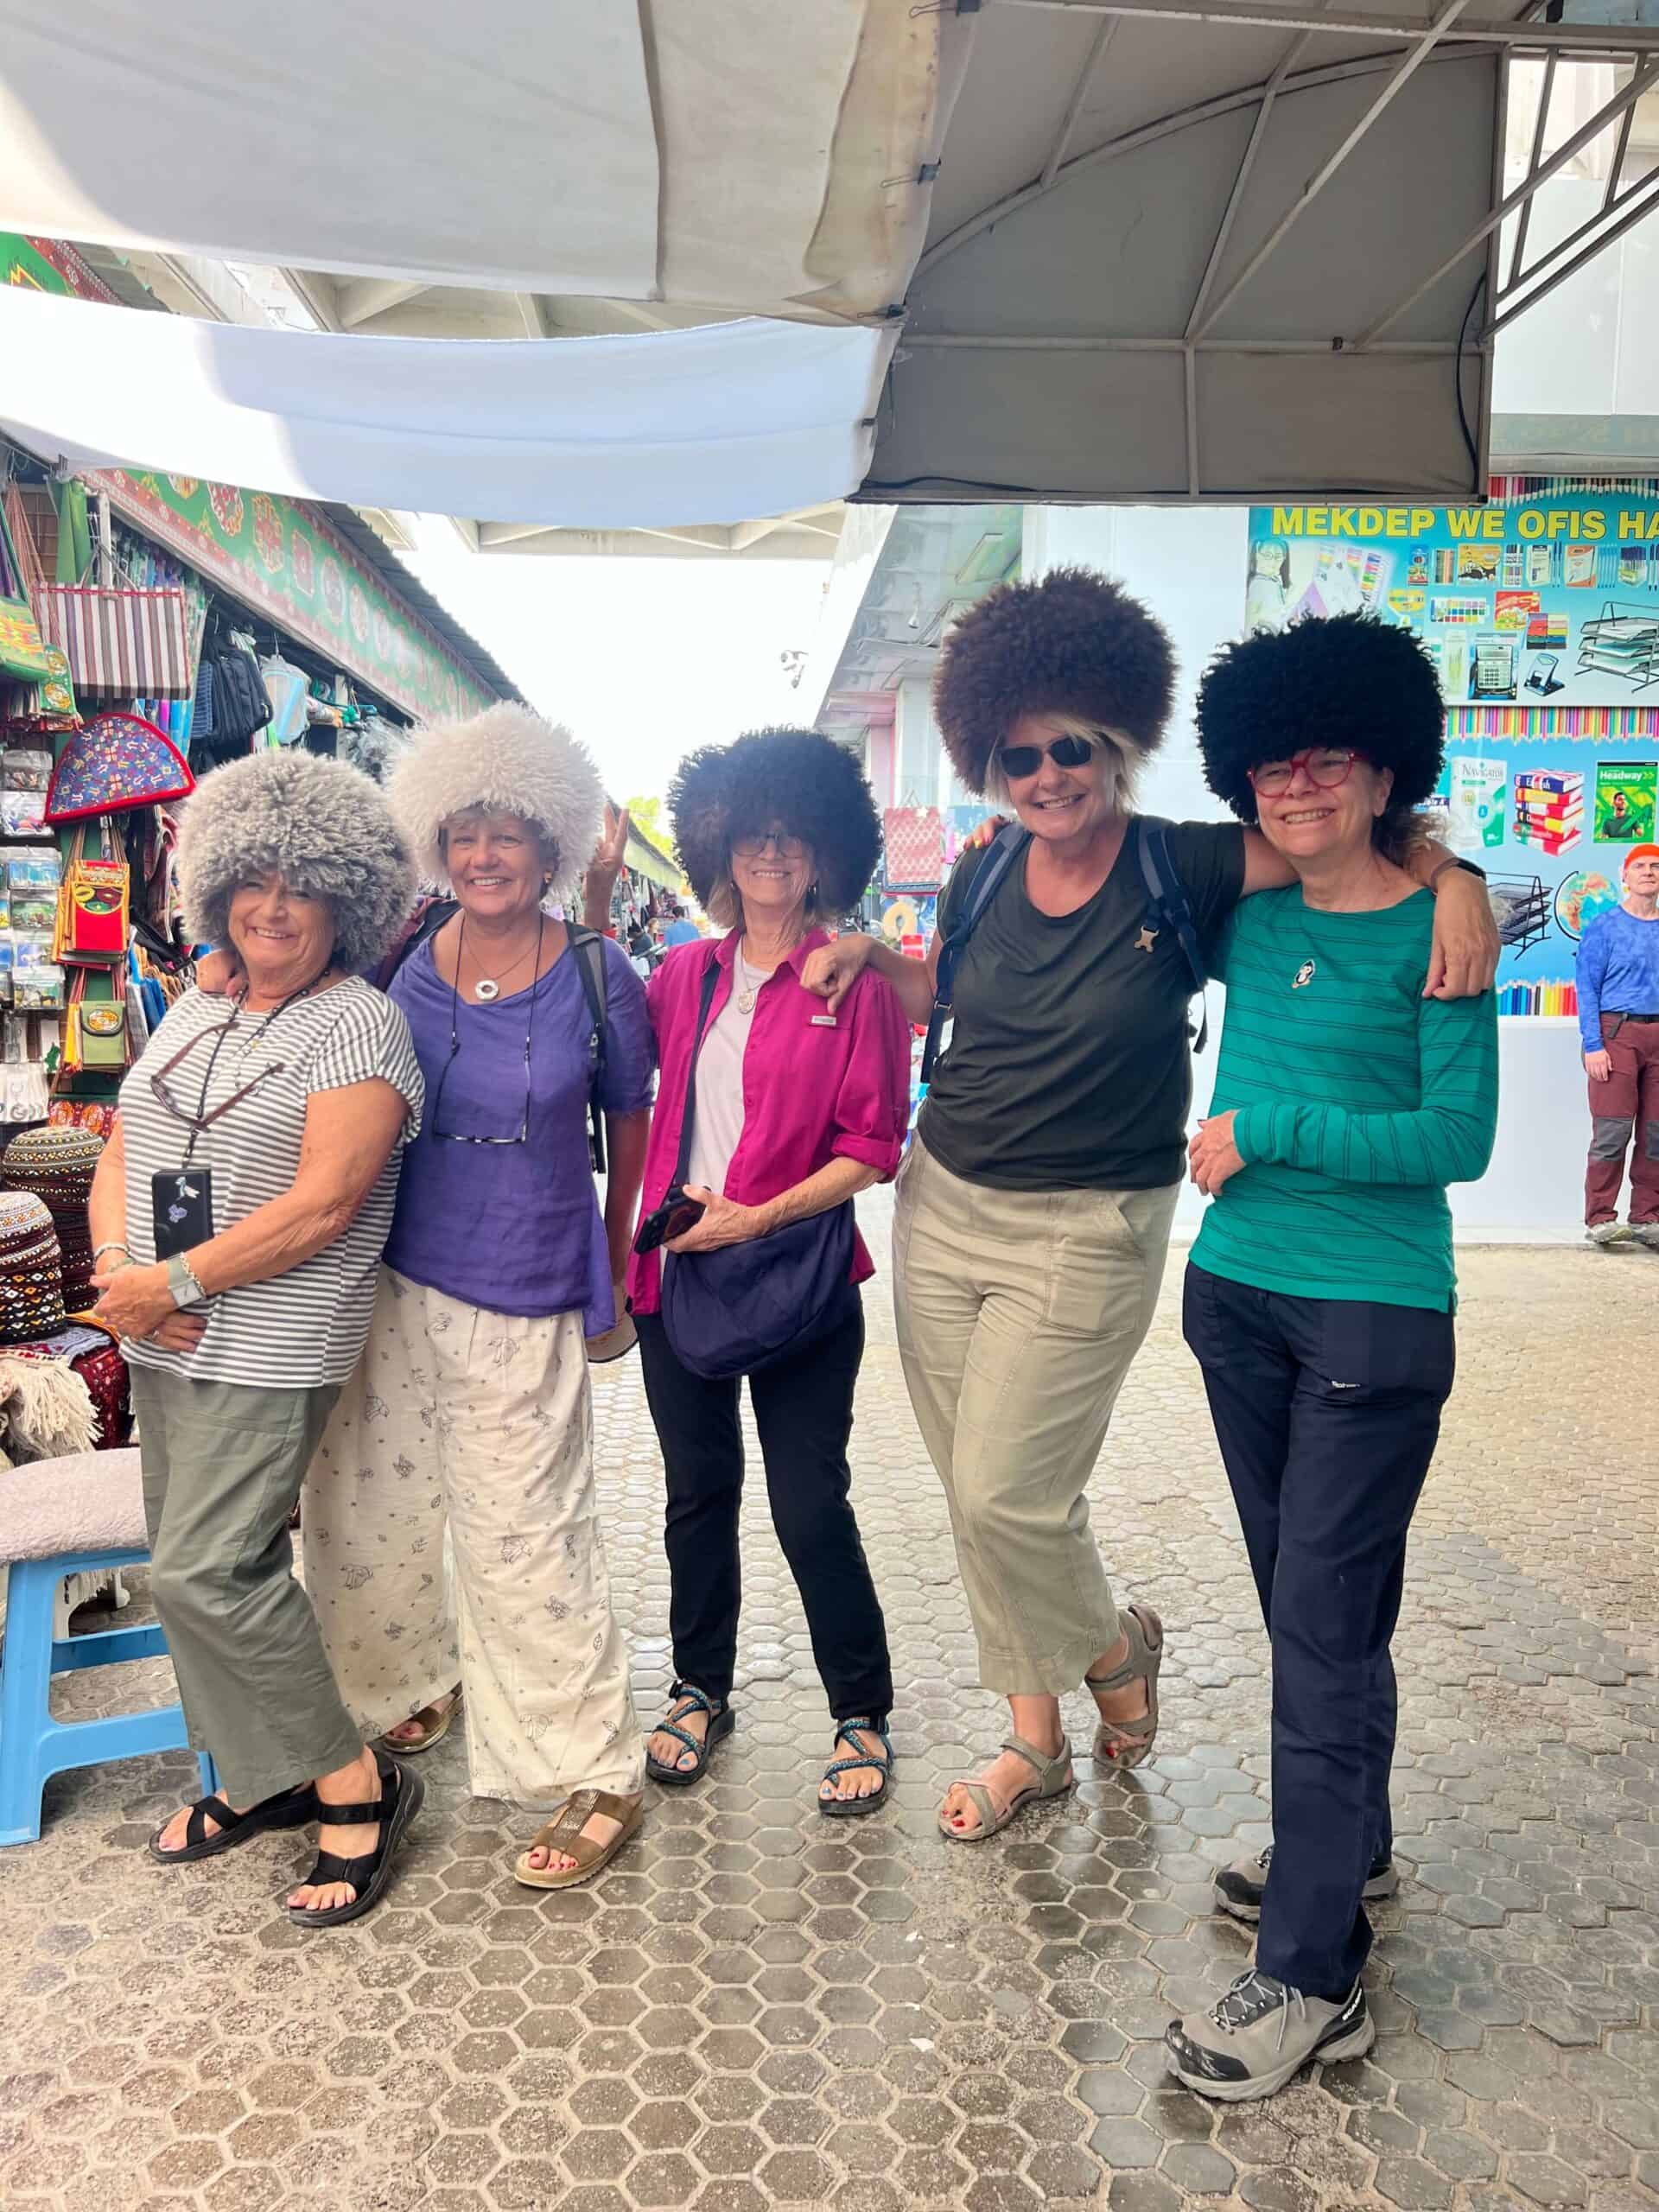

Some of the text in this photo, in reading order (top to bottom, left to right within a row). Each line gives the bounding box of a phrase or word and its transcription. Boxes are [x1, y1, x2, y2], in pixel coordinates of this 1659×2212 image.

[1272, 506, 1435, 537] MEKDEP
[1446, 509, 1506, 539] WE
[1517, 509, 1606, 540] OFIS
[1599, 769, 1643, 782] Headway
